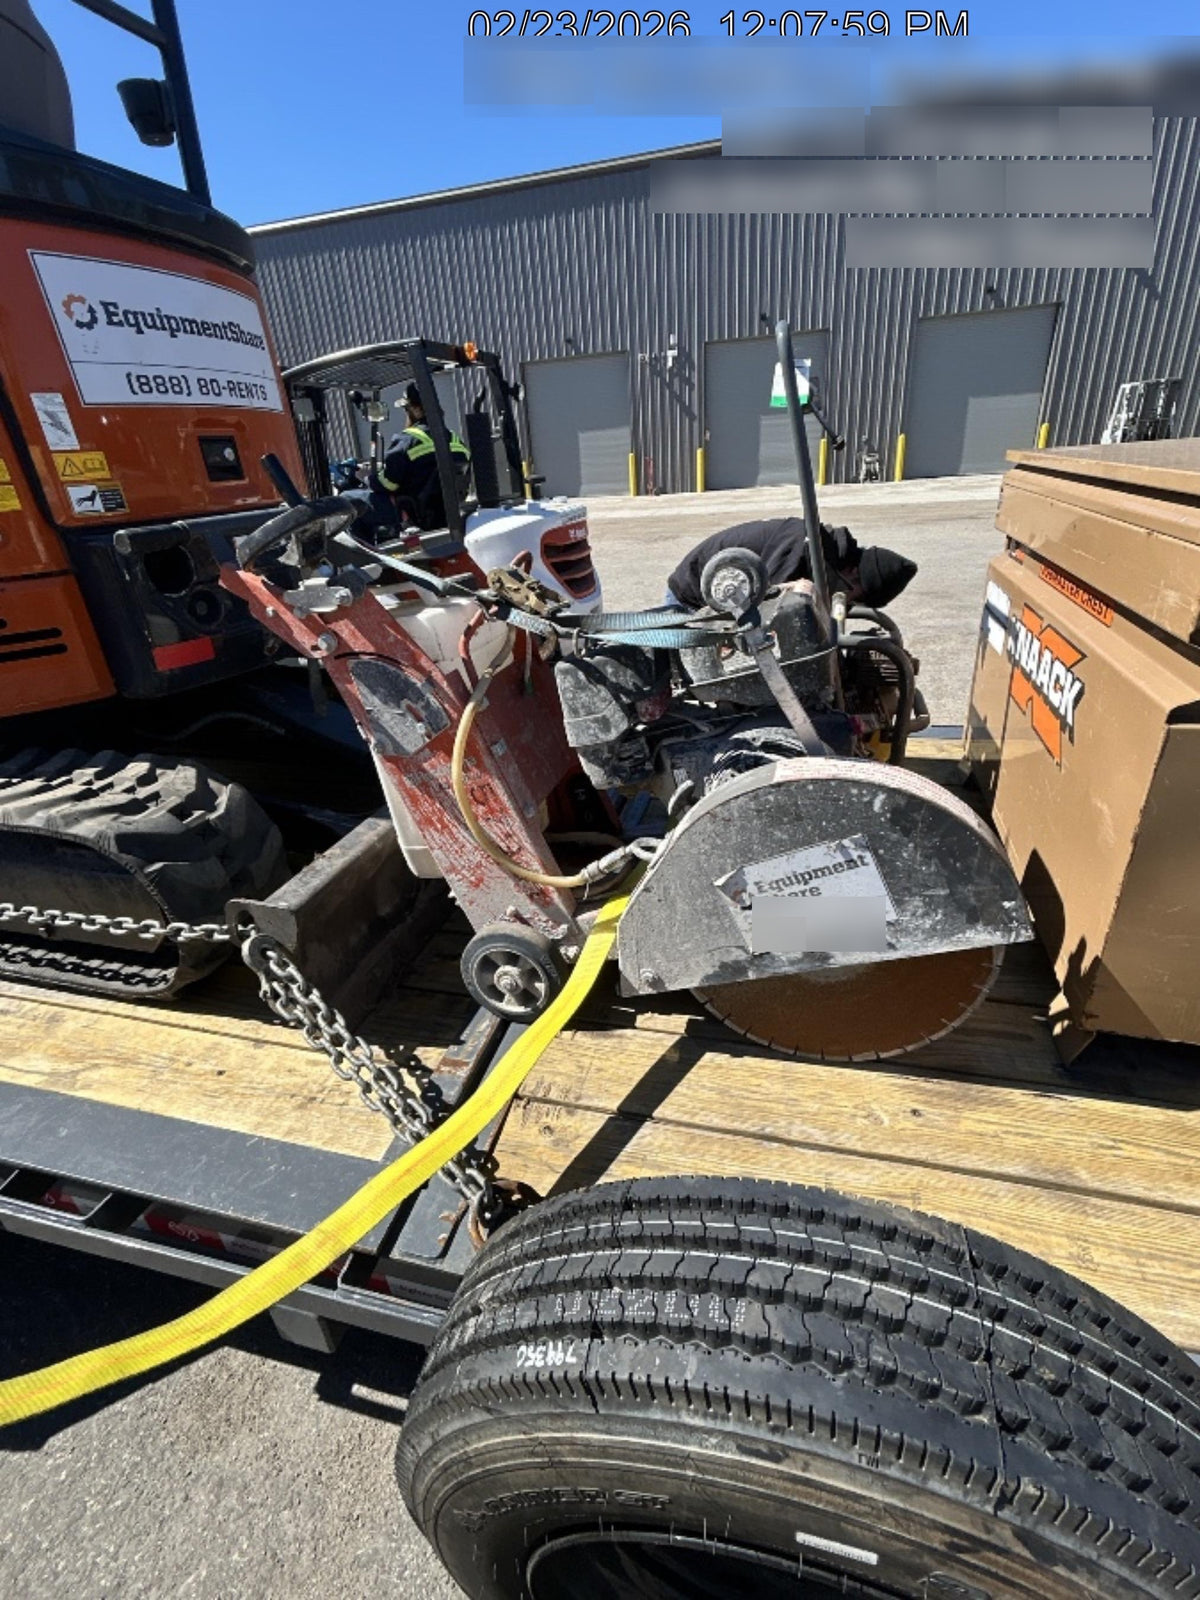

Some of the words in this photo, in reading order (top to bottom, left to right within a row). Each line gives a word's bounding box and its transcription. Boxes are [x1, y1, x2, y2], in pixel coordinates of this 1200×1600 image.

[100, 300, 267, 351] EquipmentShare
[126, 371, 192, 397] (888)
[197, 376, 268, 402] 80-RENTS
[753, 854, 870, 893] Equipment
